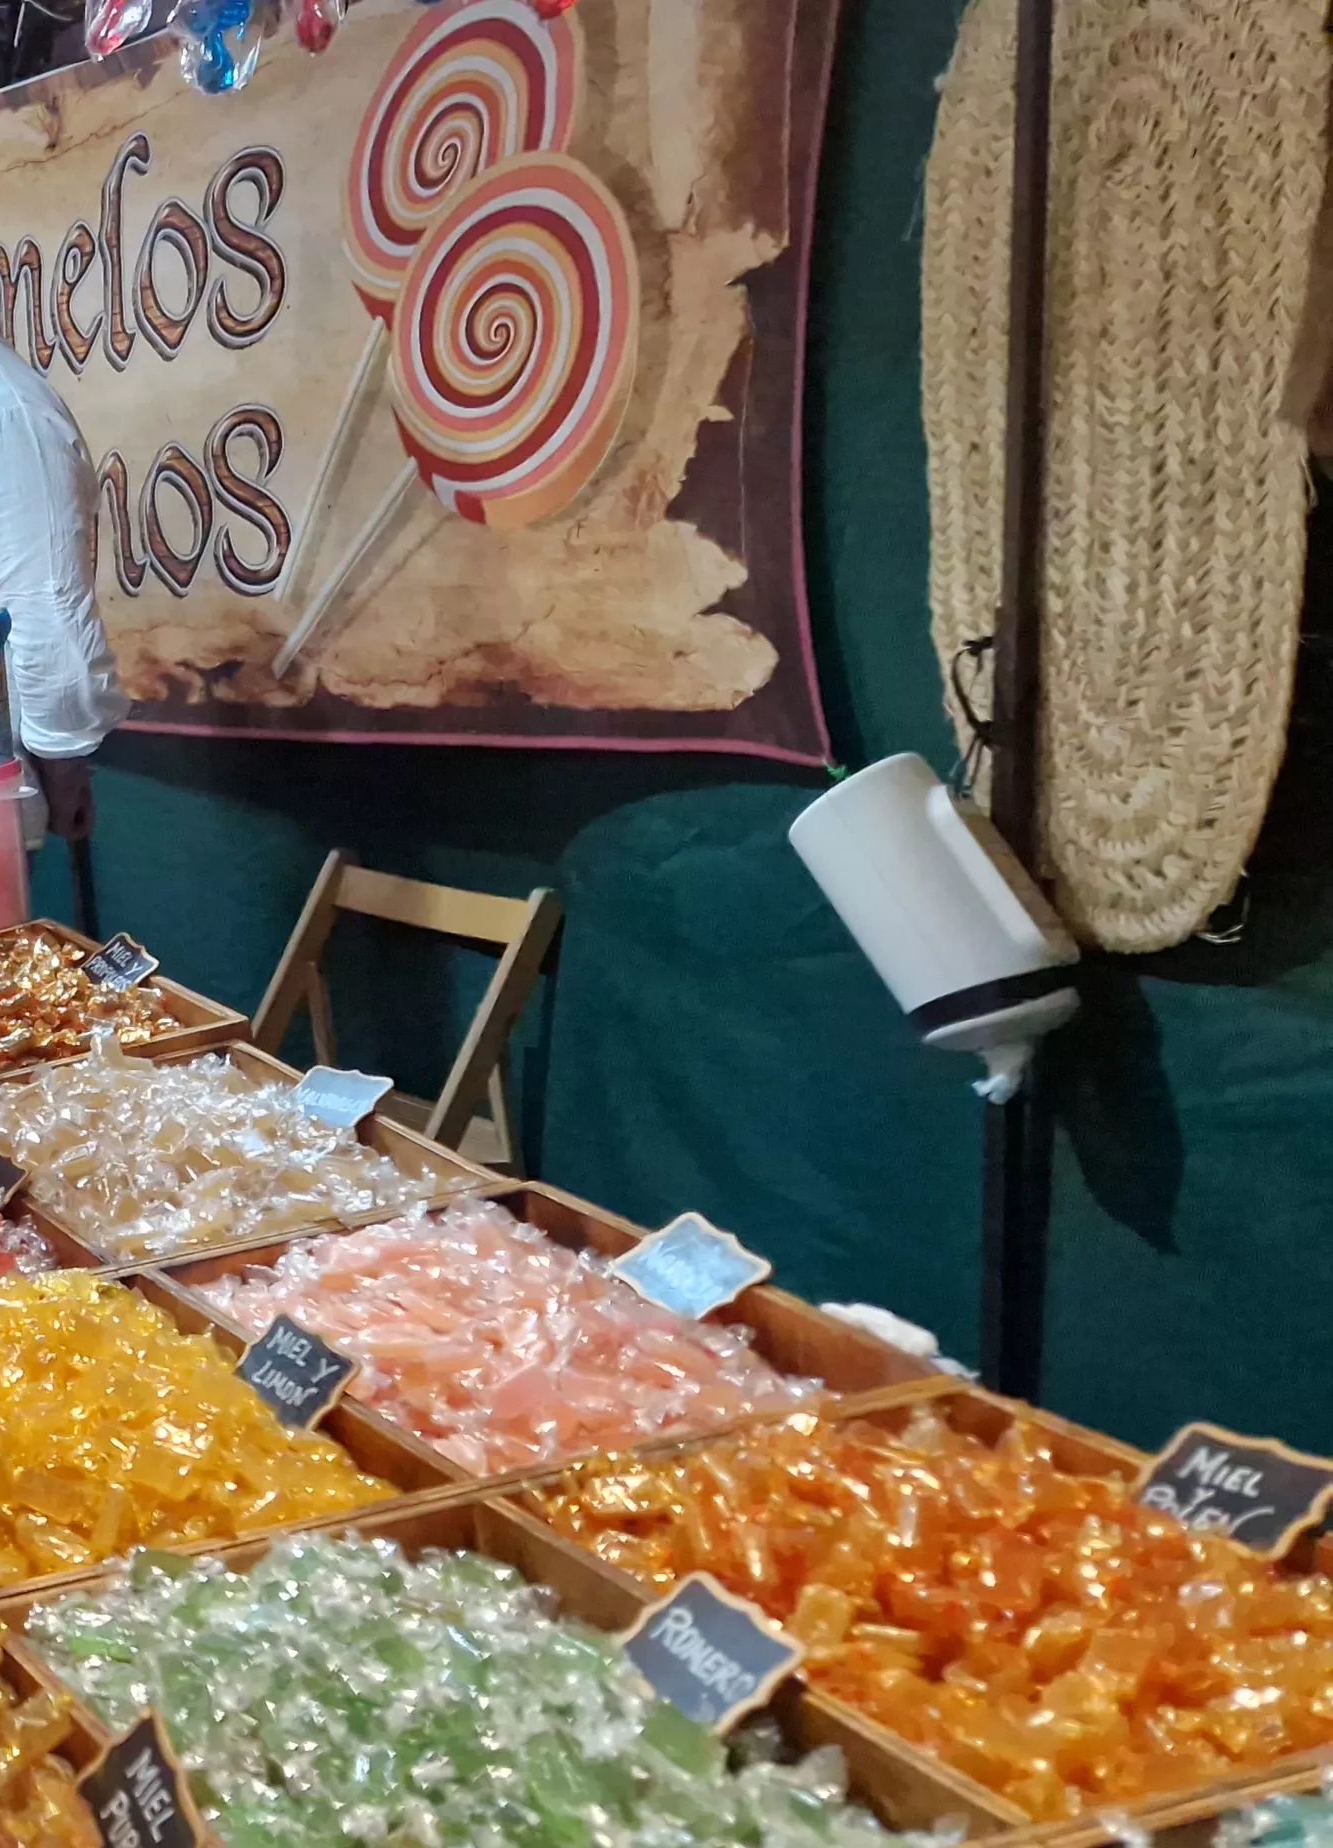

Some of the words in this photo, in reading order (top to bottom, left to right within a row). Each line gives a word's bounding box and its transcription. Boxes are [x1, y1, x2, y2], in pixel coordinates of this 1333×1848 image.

[105, 941, 133, 968] MIEL
[124, 961, 144, 976] Y
[266, 1325, 313, 1367] MIEL
[311, 1357, 341, 1384] Y
[1175, 1445, 1265, 1499] MIEL
[649, 1605, 758, 1703] ROMERO
[124, 1747, 175, 1844] MIEL
